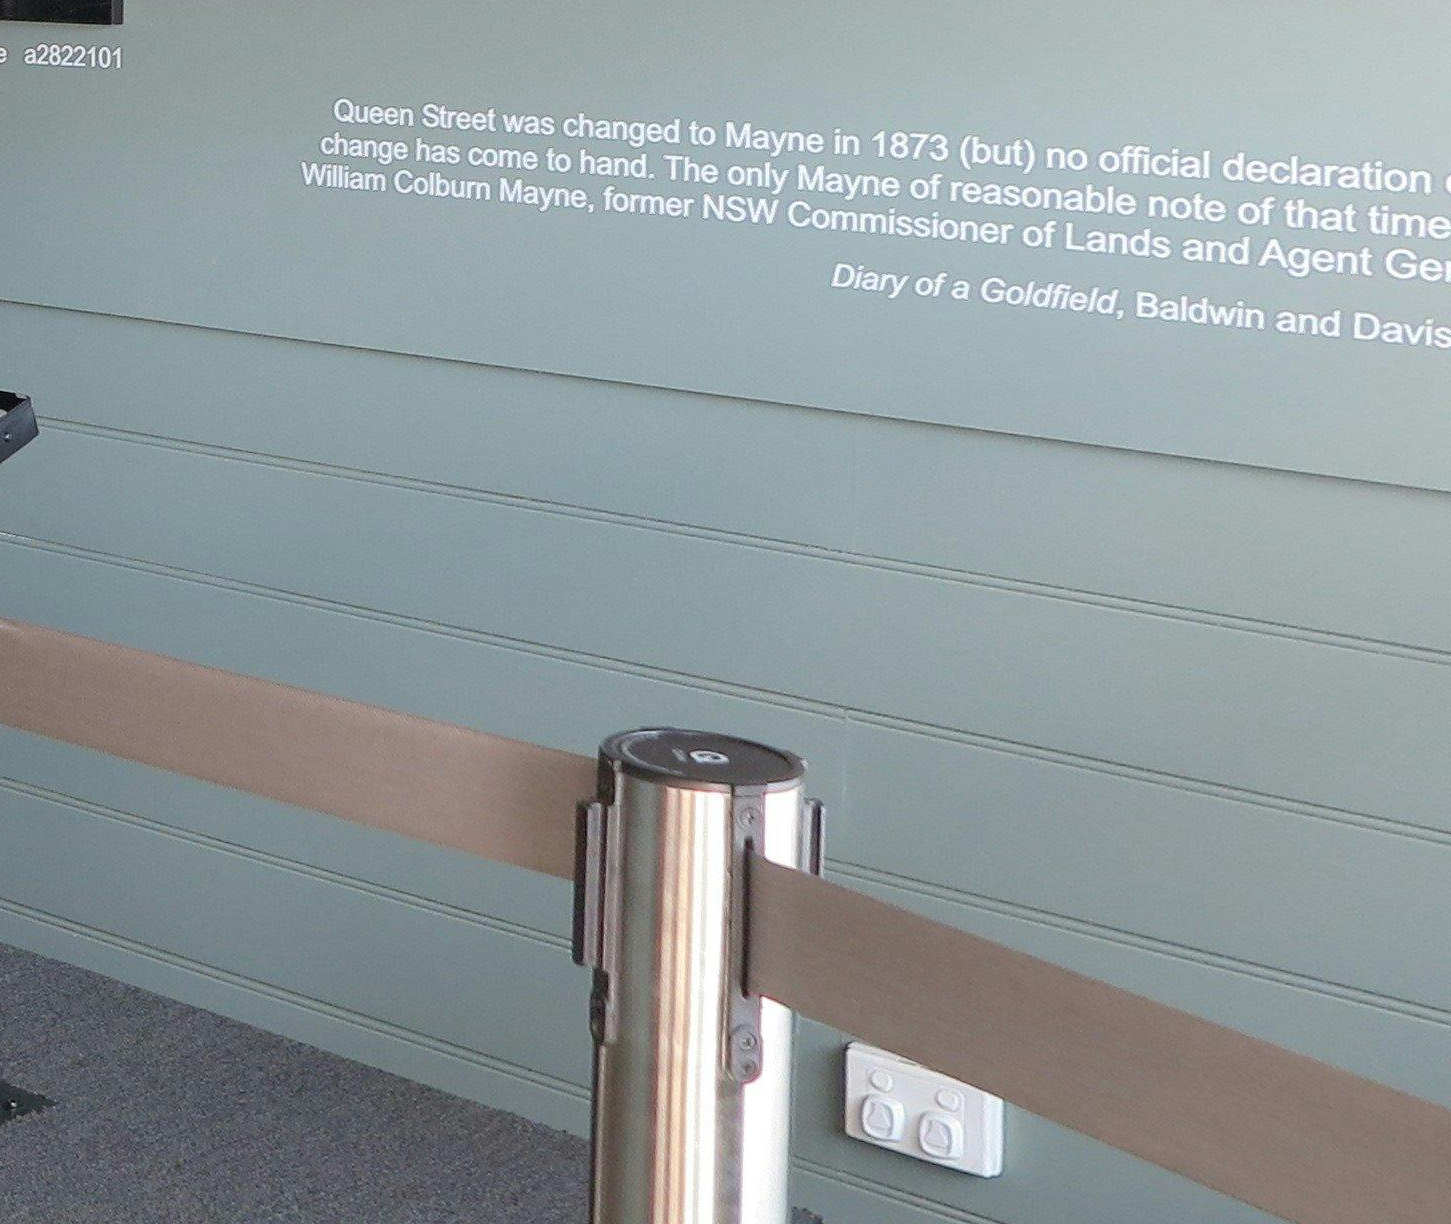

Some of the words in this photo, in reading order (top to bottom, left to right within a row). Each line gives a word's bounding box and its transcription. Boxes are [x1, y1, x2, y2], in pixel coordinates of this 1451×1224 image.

[24, 43, 122, 69] a2822101
[319, 131, 409, 164] change
[415, 137, 461, 166] has
[468, 147, 539, 170] come
[545, 150, 572, 174] to
[580, 149, 655, 179] hand.
[662, 153, 720, 184] The
[727, 161, 791, 195] only
[798, 163, 900, 202] Mayne
[910, 174, 942, 202] of
[949, 179, 1137, 217] reasonable
[1147, 190, 1227, 223] note
[1237, 196, 1276, 226] of
[1283, 198, 1357, 234] that
[1367, 204, 1451, 241] time
[333, 98, 414, 128] Queen
[422, 102, 497, 133] Street
[502, 114, 555, 136] was
[563, 114, 680, 147] changed
[688, 123, 715, 147] to
[725, 122, 824, 158] Mayne
[834, 128, 860, 156] in
[873, 131, 949, 162] 1873
[960, 136, 1035, 174] (but)
[1045, 147, 1088, 171] no
[1098, 145, 1210, 180] official
[1221, 155, 1432, 194] declaration
[301, 161, 387, 193] William
[394, 170, 491, 201] Colburn
[499, 178, 595, 215] Mayne,
[602, 186, 695, 219] former
[701, 194, 779, 225] NSW
[788, 197, 1014, 247] Commissioner
[1023, 221, 1058, 250] of
[1064, 222, 1172, 259] Lands
[1182, 236, 1250, 266] and
[1258, 239, 1373, 278] Agent
[831, 263, 908, 298] Diary
[915, 272, 947, 298] of
[952, 279, 970, 301] a
[980, 278, 1126, 320] Goldfield,
[1135, 290, 1266, 331] Baldwin
[1275, 308, 1341, 339] and
[1353, 311, 1451, 350] Davis
